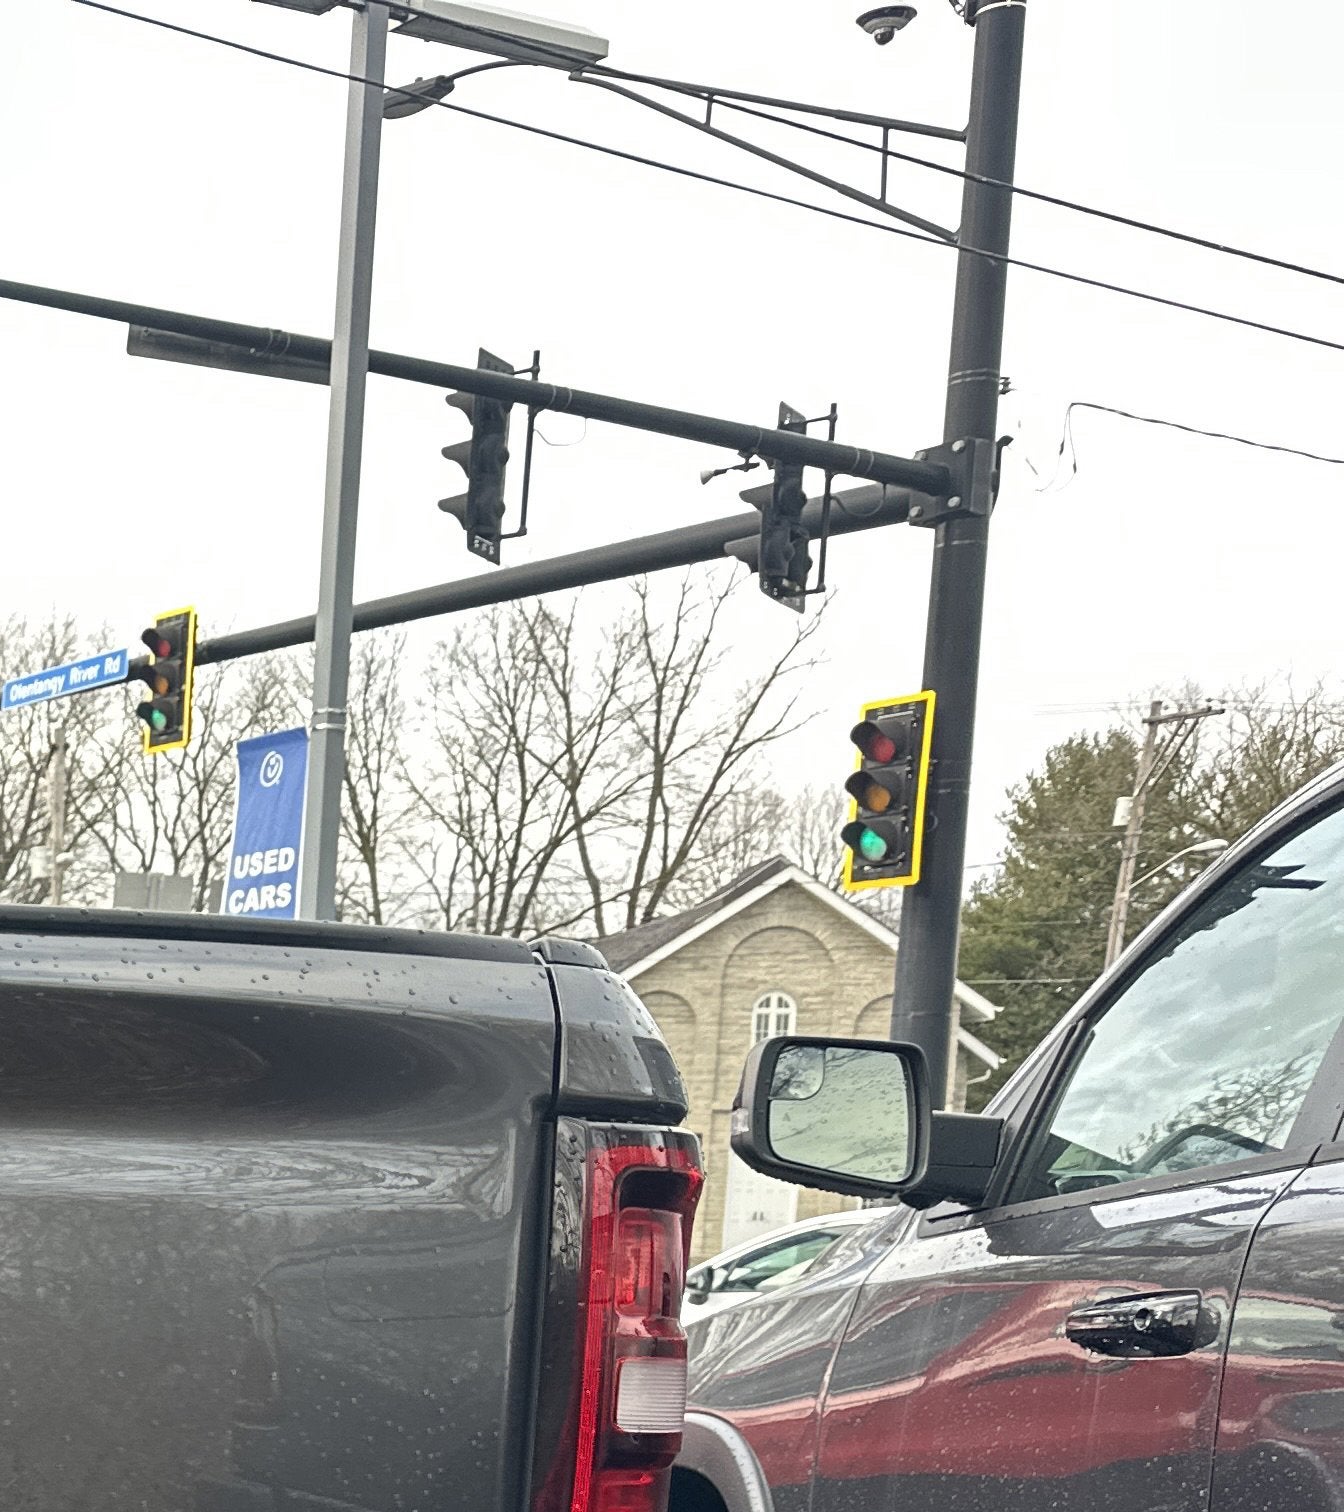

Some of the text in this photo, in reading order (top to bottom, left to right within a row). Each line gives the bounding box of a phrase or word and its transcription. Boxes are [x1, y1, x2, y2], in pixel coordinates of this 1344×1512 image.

[9, 655, 121, 702] Olentangy River Rd
[233, 847, 295, 880] USED
[228, 882, 292, 914] CARS
